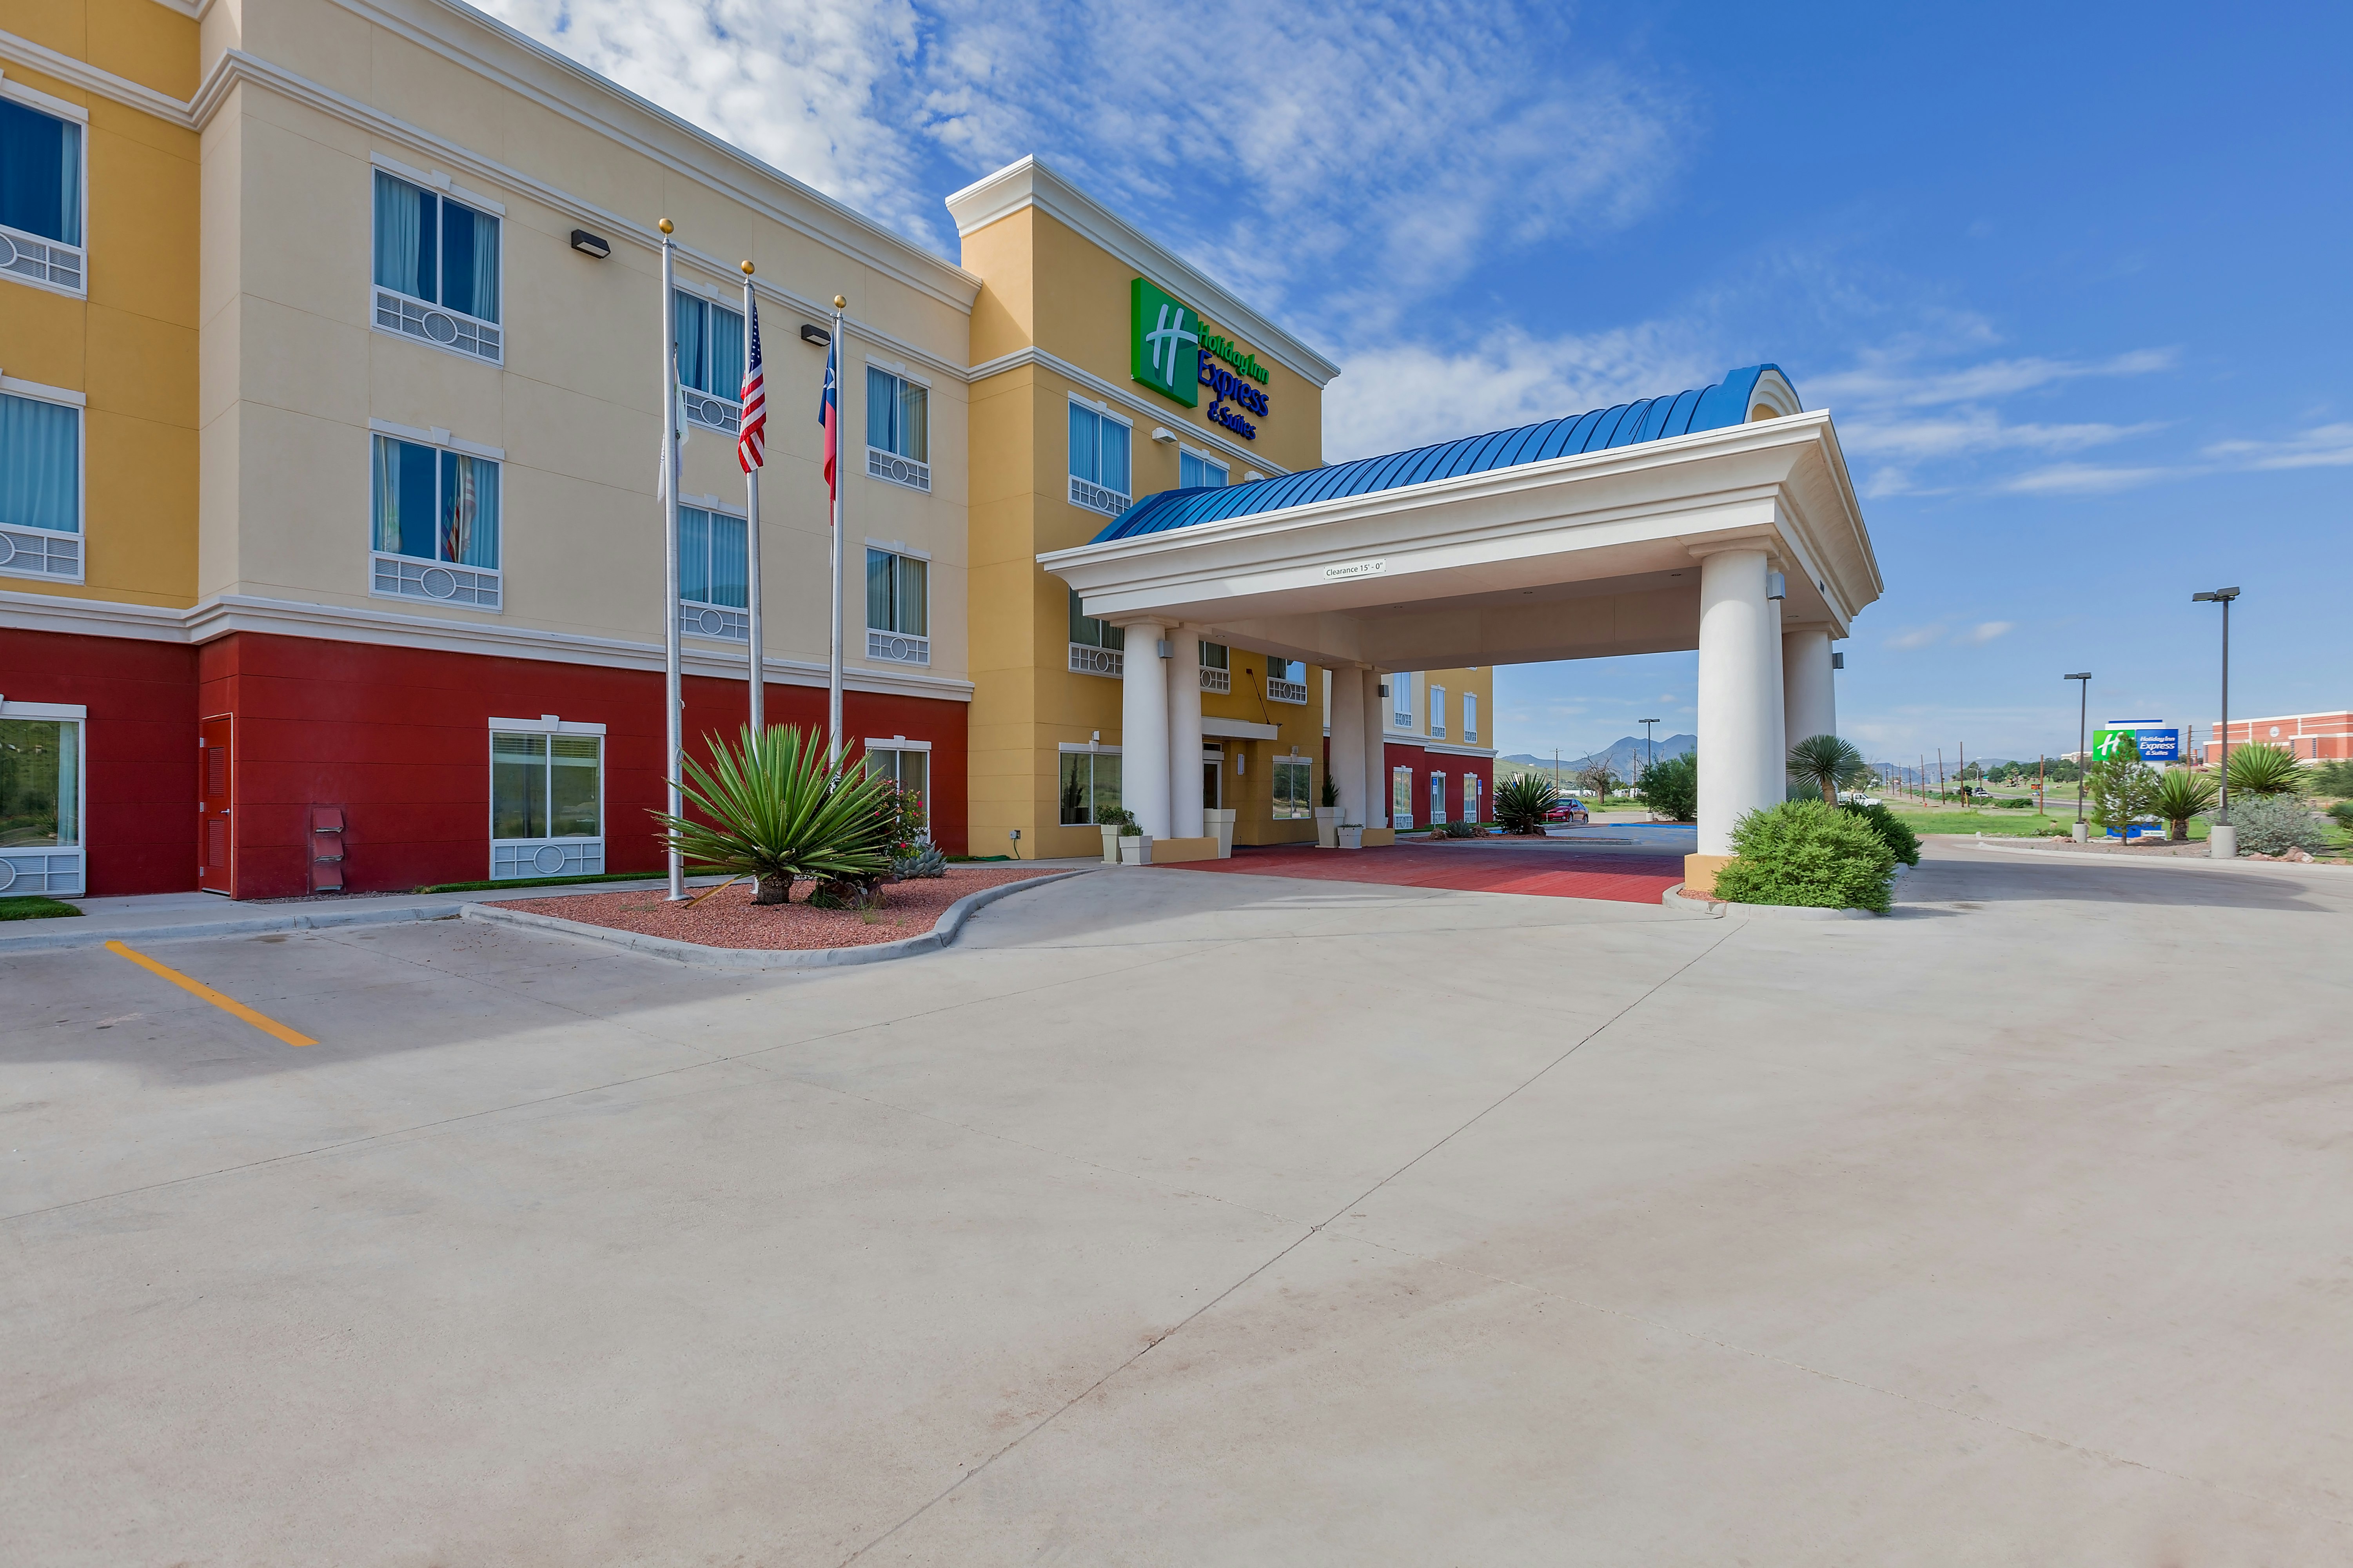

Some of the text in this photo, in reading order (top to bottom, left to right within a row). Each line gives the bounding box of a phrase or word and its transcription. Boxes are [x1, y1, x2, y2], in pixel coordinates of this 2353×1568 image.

[1198, 321, 1269, 385] Holiday Inn
[1198, 349, 1269, 417] Express
[1207, 400, 1256, 441] & Suites
[1326, 567, 1358, 576] Clearance
[2140, 742, 2176, 751] Express
